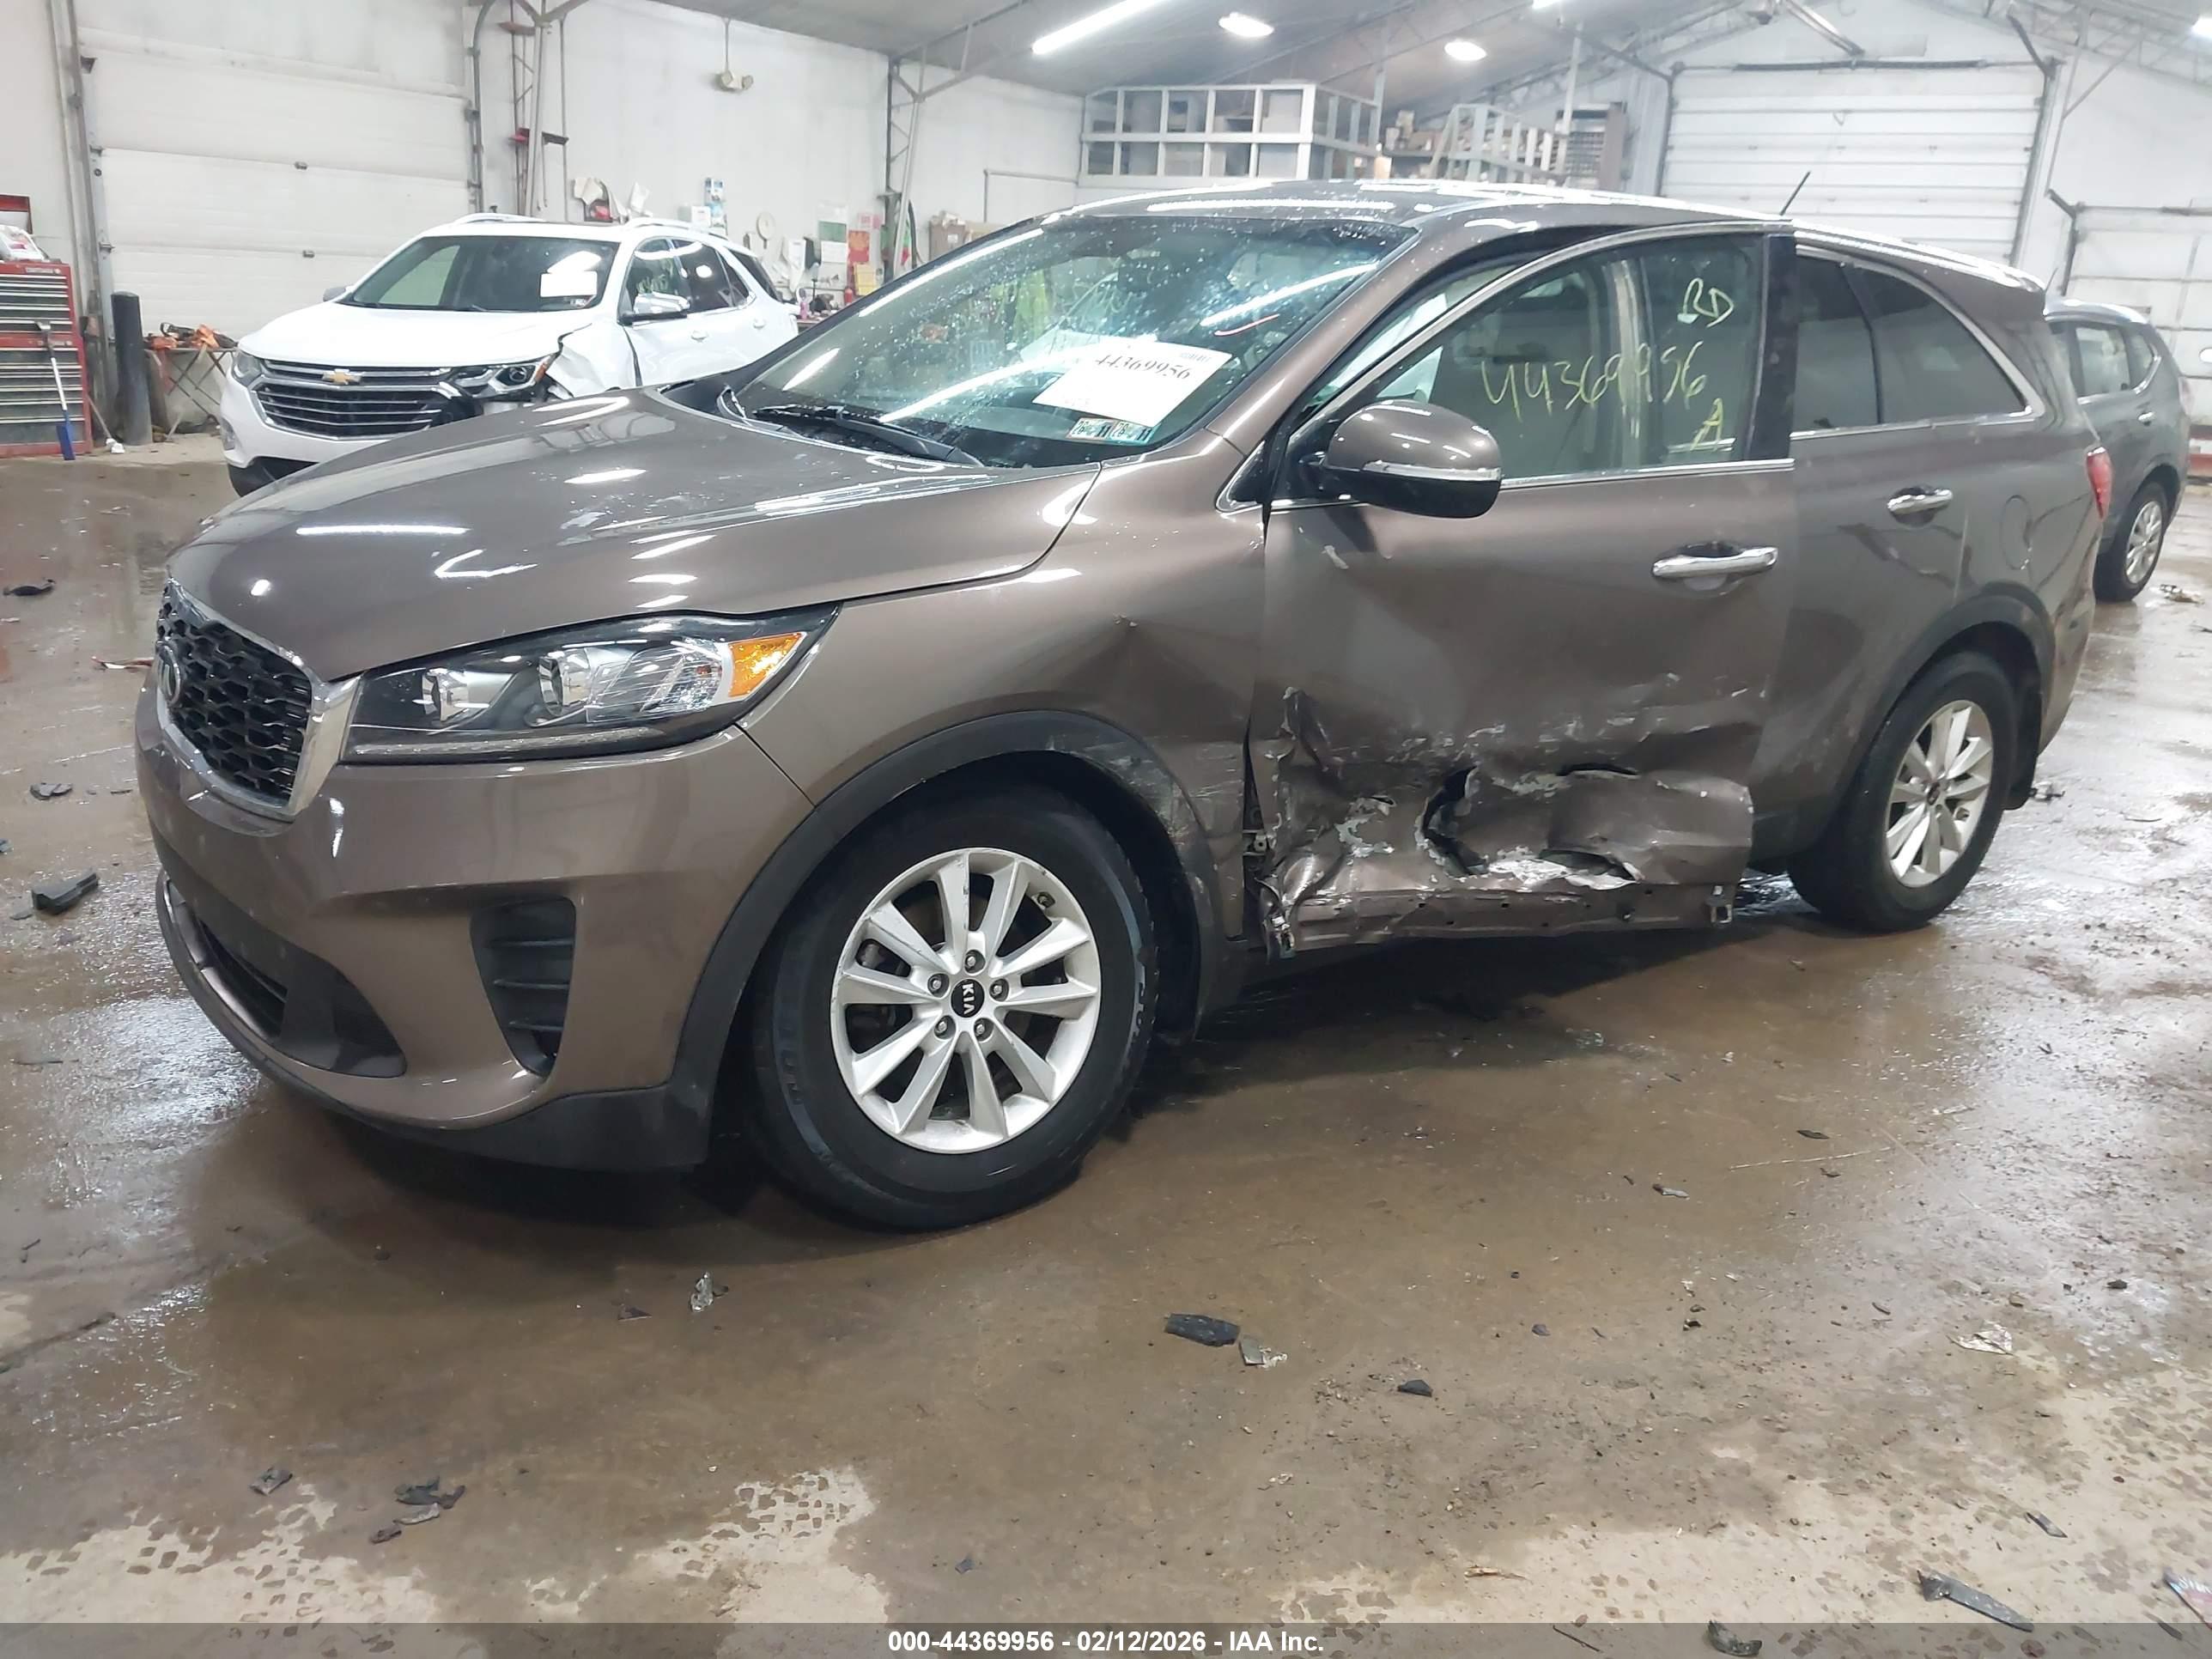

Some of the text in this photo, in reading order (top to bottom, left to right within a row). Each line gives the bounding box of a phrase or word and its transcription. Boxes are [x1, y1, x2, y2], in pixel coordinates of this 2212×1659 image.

[1095, 354, 1192, 379] 44369956
[1480, 340, 1708, 423] 44369956
[1691, 398, 1724, 453] A
[962, 982, 975, 1015] KIA
